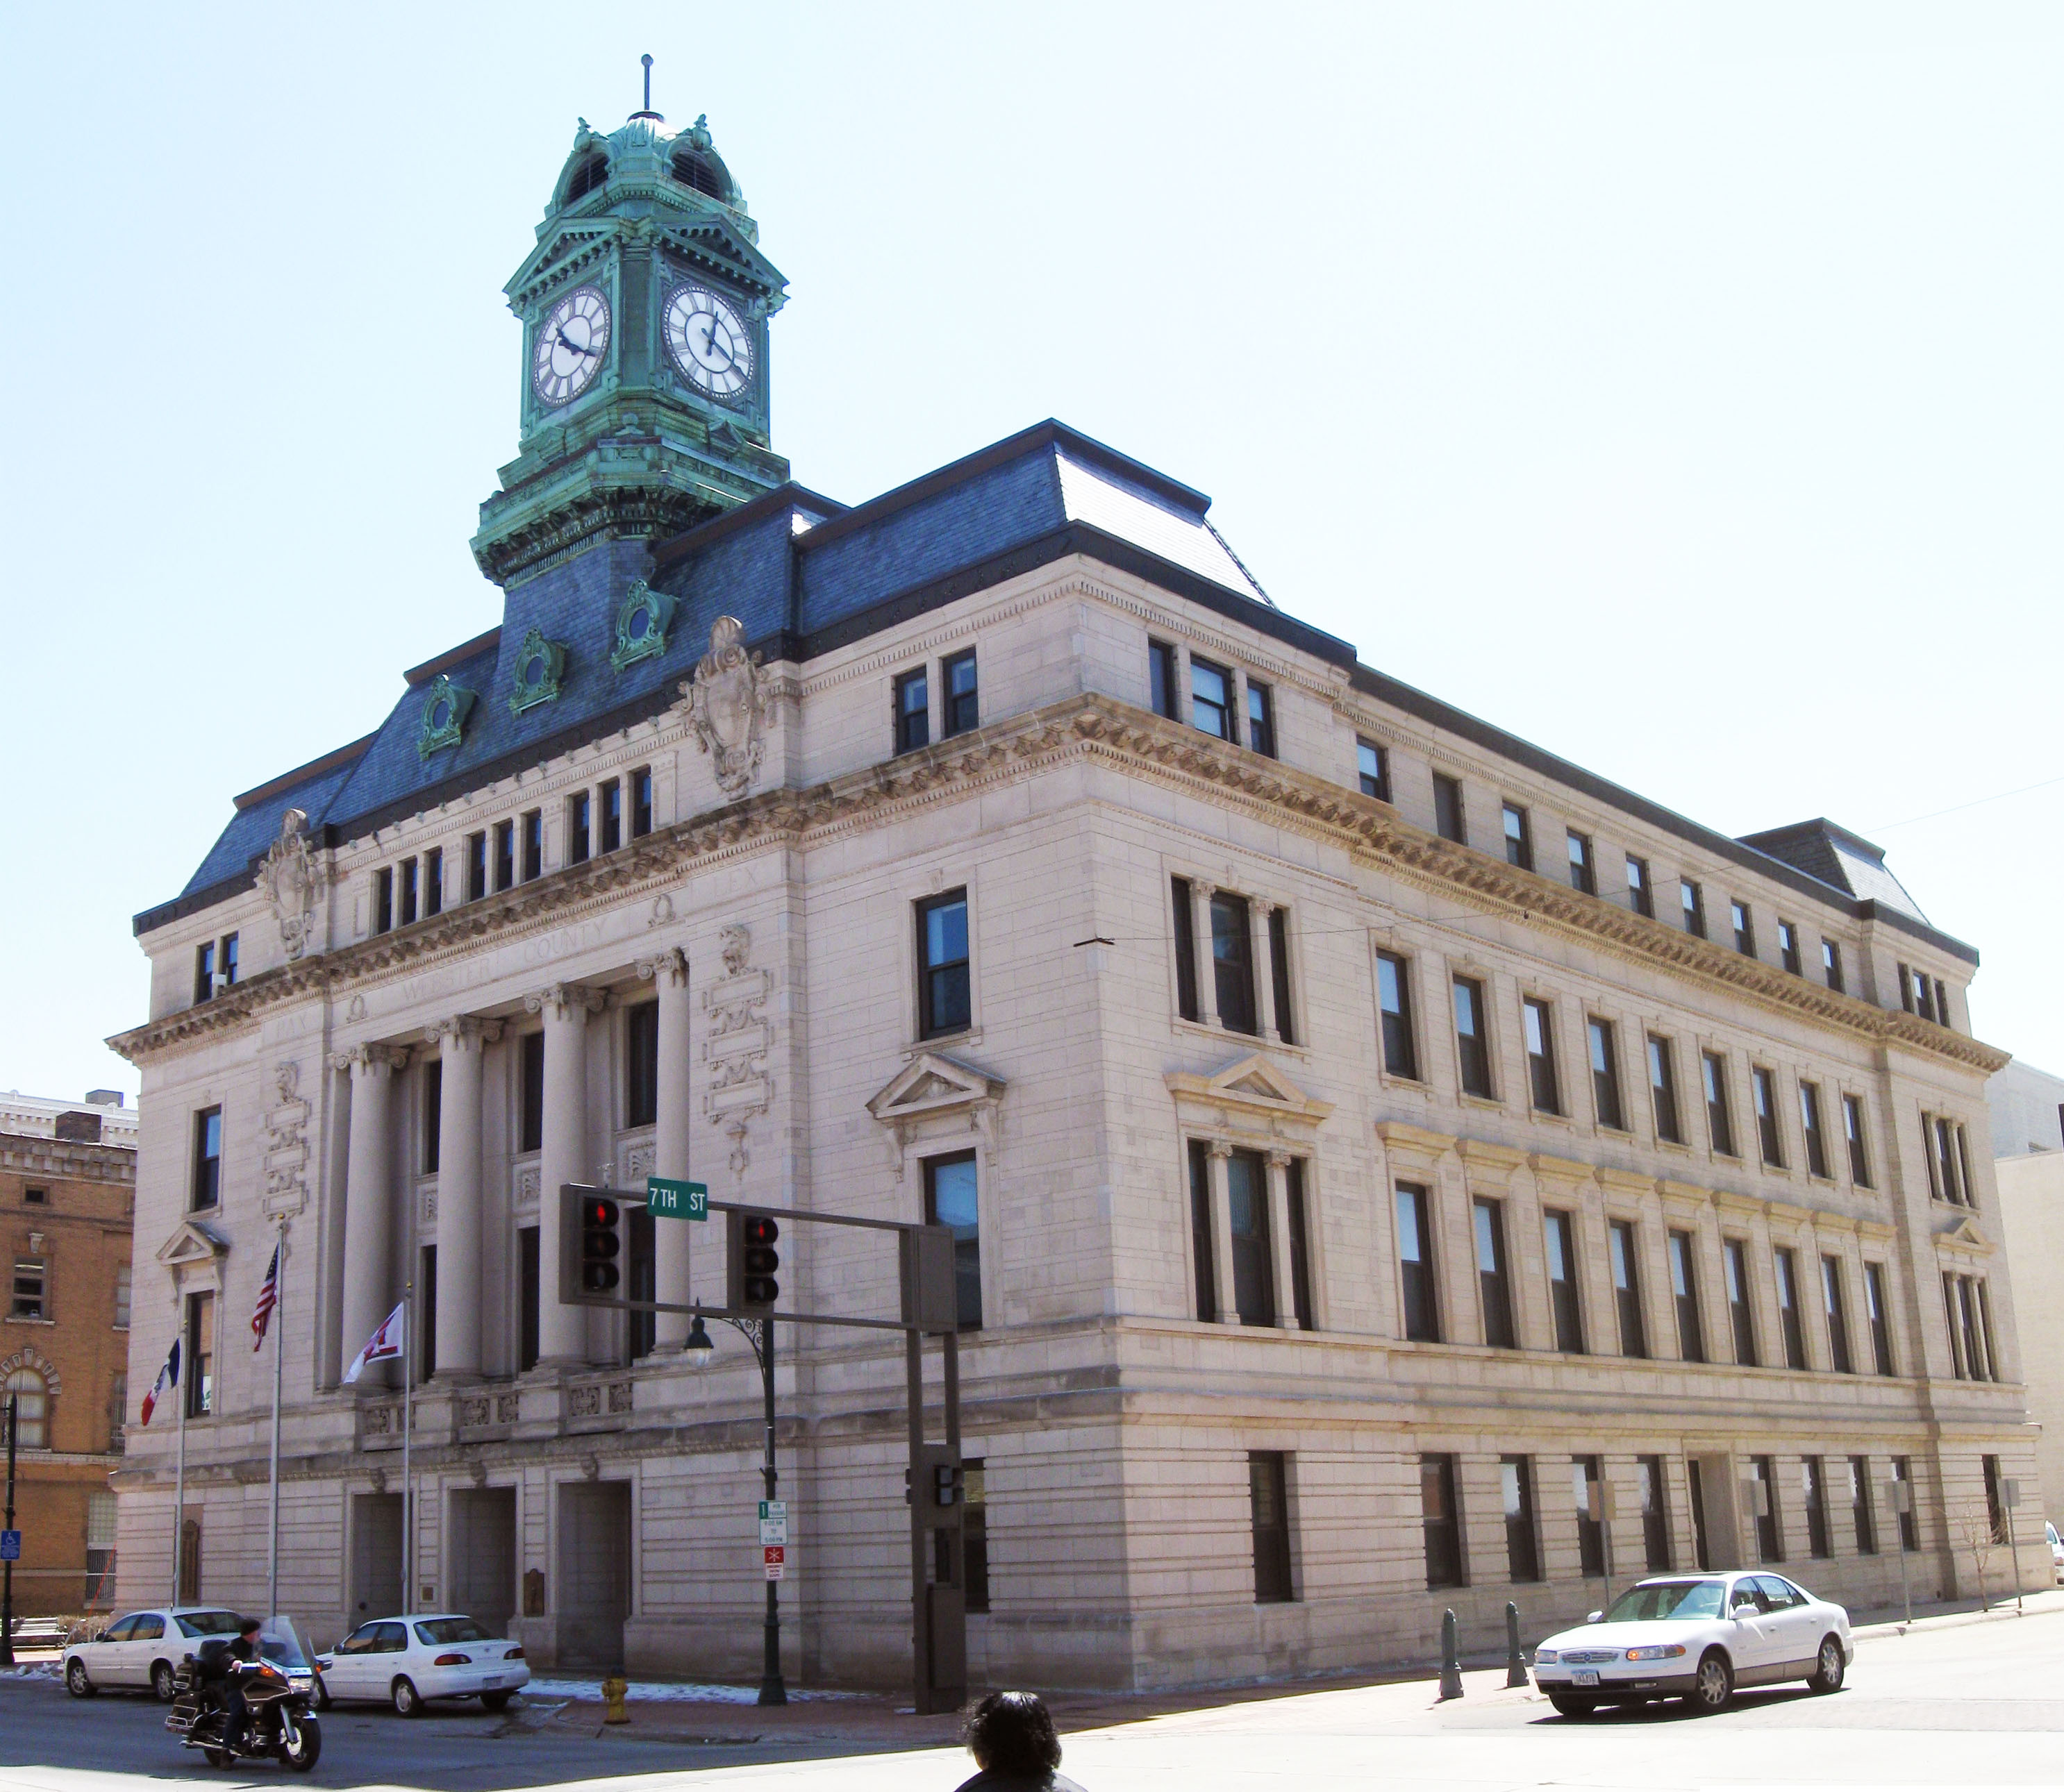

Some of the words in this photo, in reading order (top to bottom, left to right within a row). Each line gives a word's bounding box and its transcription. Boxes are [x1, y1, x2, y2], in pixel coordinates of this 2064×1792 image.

[401, 959, 491, 1000] WEBSTER
[524, 916, 608, 963] COUNTY
[649, 1187, 677, 1208] 7TH
[690, 1192, 705, 1212] ST
